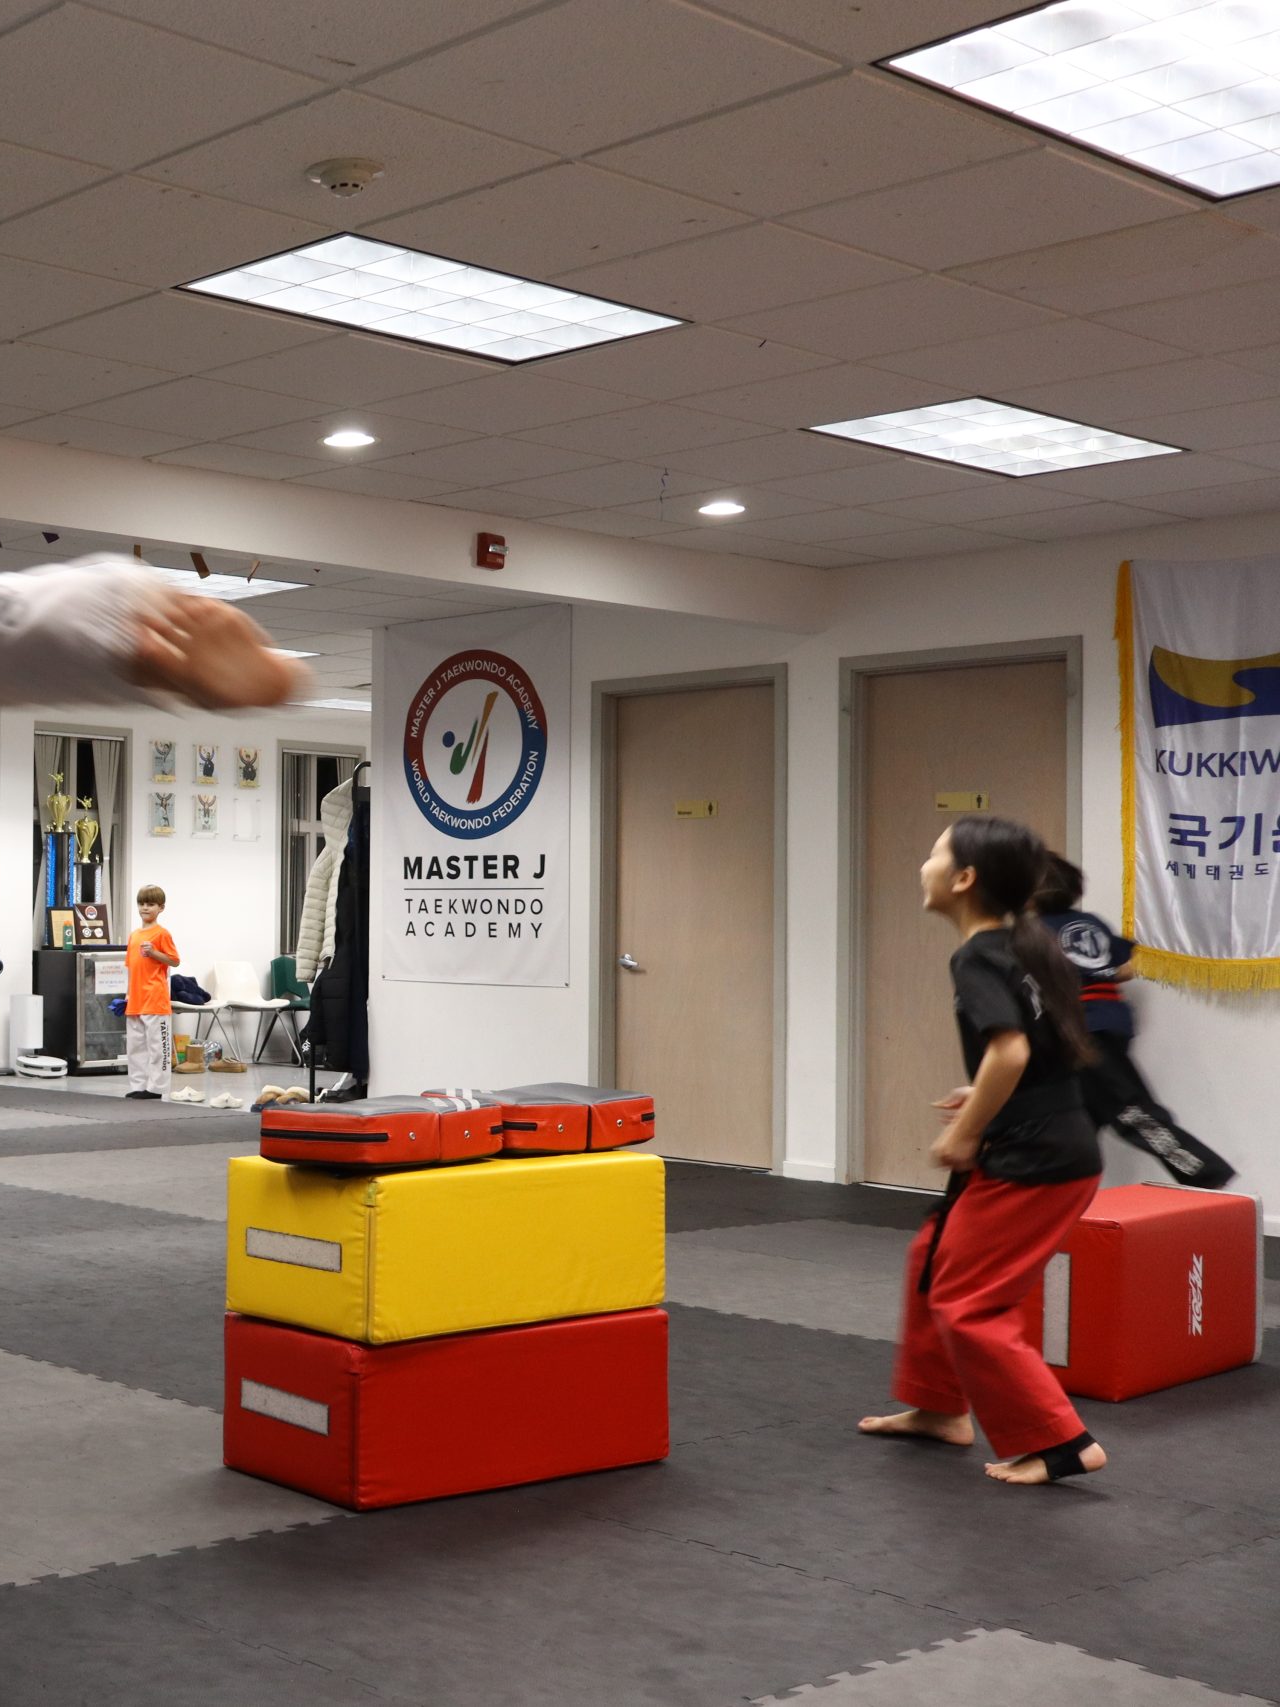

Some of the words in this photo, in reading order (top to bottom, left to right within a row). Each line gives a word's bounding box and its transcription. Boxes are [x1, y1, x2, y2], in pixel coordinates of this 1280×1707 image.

[410, 687, 436, 738] MASTER
[436, 680, 442, 690] J
[441, 660, 506, 683] TAEKWONDO
[506, 674, 539, 730] ACADEMY
[411, 758, 430, 803] WORLD
[429, 800, 491, 830] TAEKWONDO
[492, 750, 539, 822] FEDERATION
[1168, 813, 1280, 857] 국기
[403, 855, 520, 880] MASTER
[533, 854, 546, 879] J
[405, 898, 543, 915] TAEKWONDO
[405, 921, 543, 939] ACADEMY
[160, 1020, 168, 1071] TAEKWONDO
